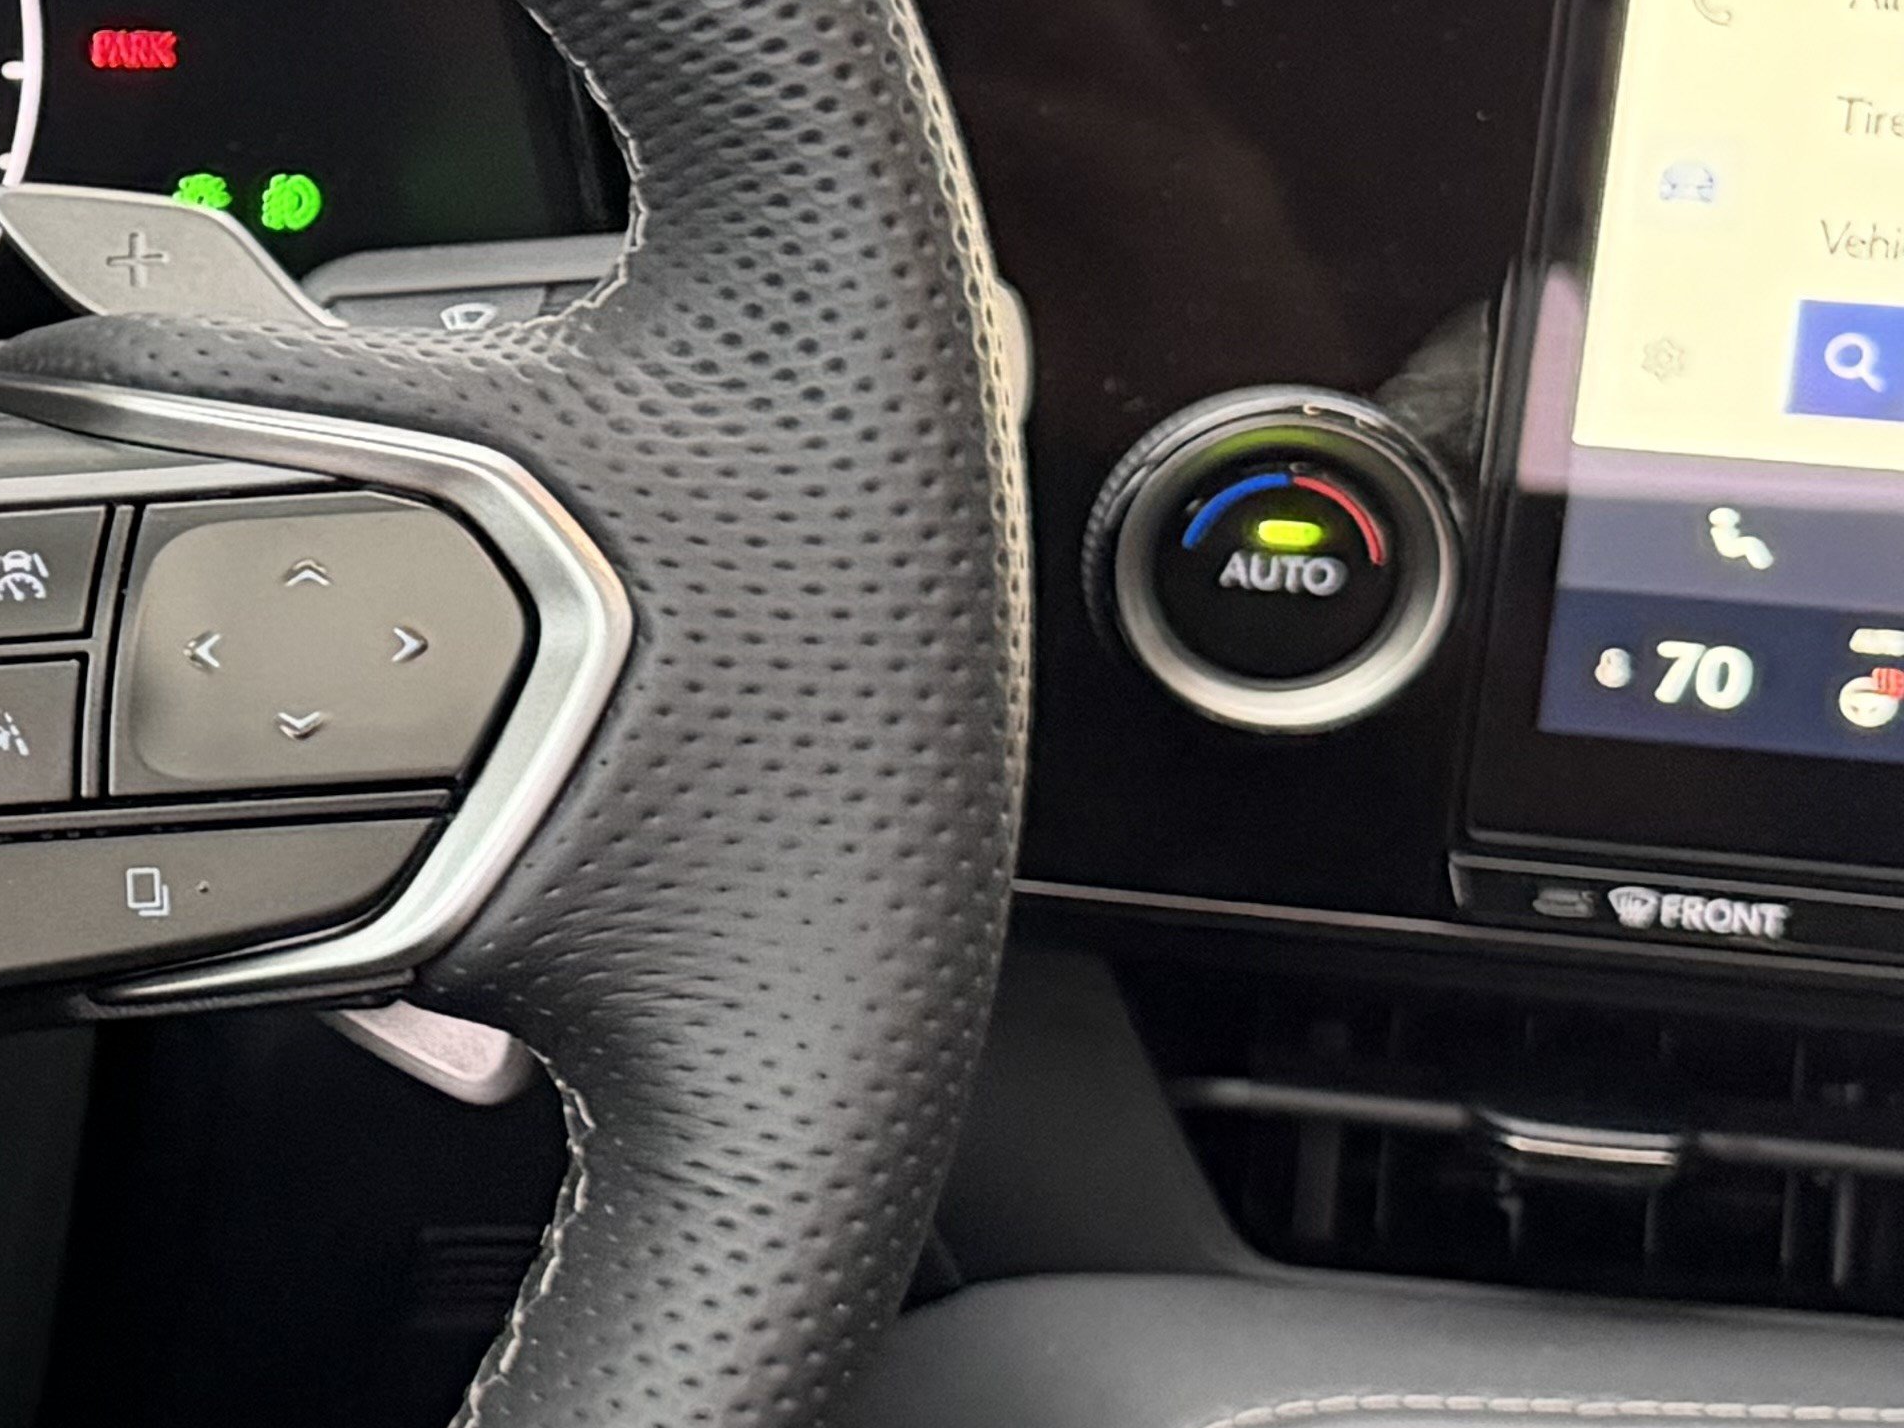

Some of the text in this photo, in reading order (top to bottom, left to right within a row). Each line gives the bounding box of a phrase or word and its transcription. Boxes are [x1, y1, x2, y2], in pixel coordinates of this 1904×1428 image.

[91, 30, 177, 69] PARK
[1820, 219, 1904, 260] Vehi
[1219, 551, 1347, 597] AUTO
[1654, 640, 1754, 710] 70
[1660, 893, 1790, 939] FRONT
